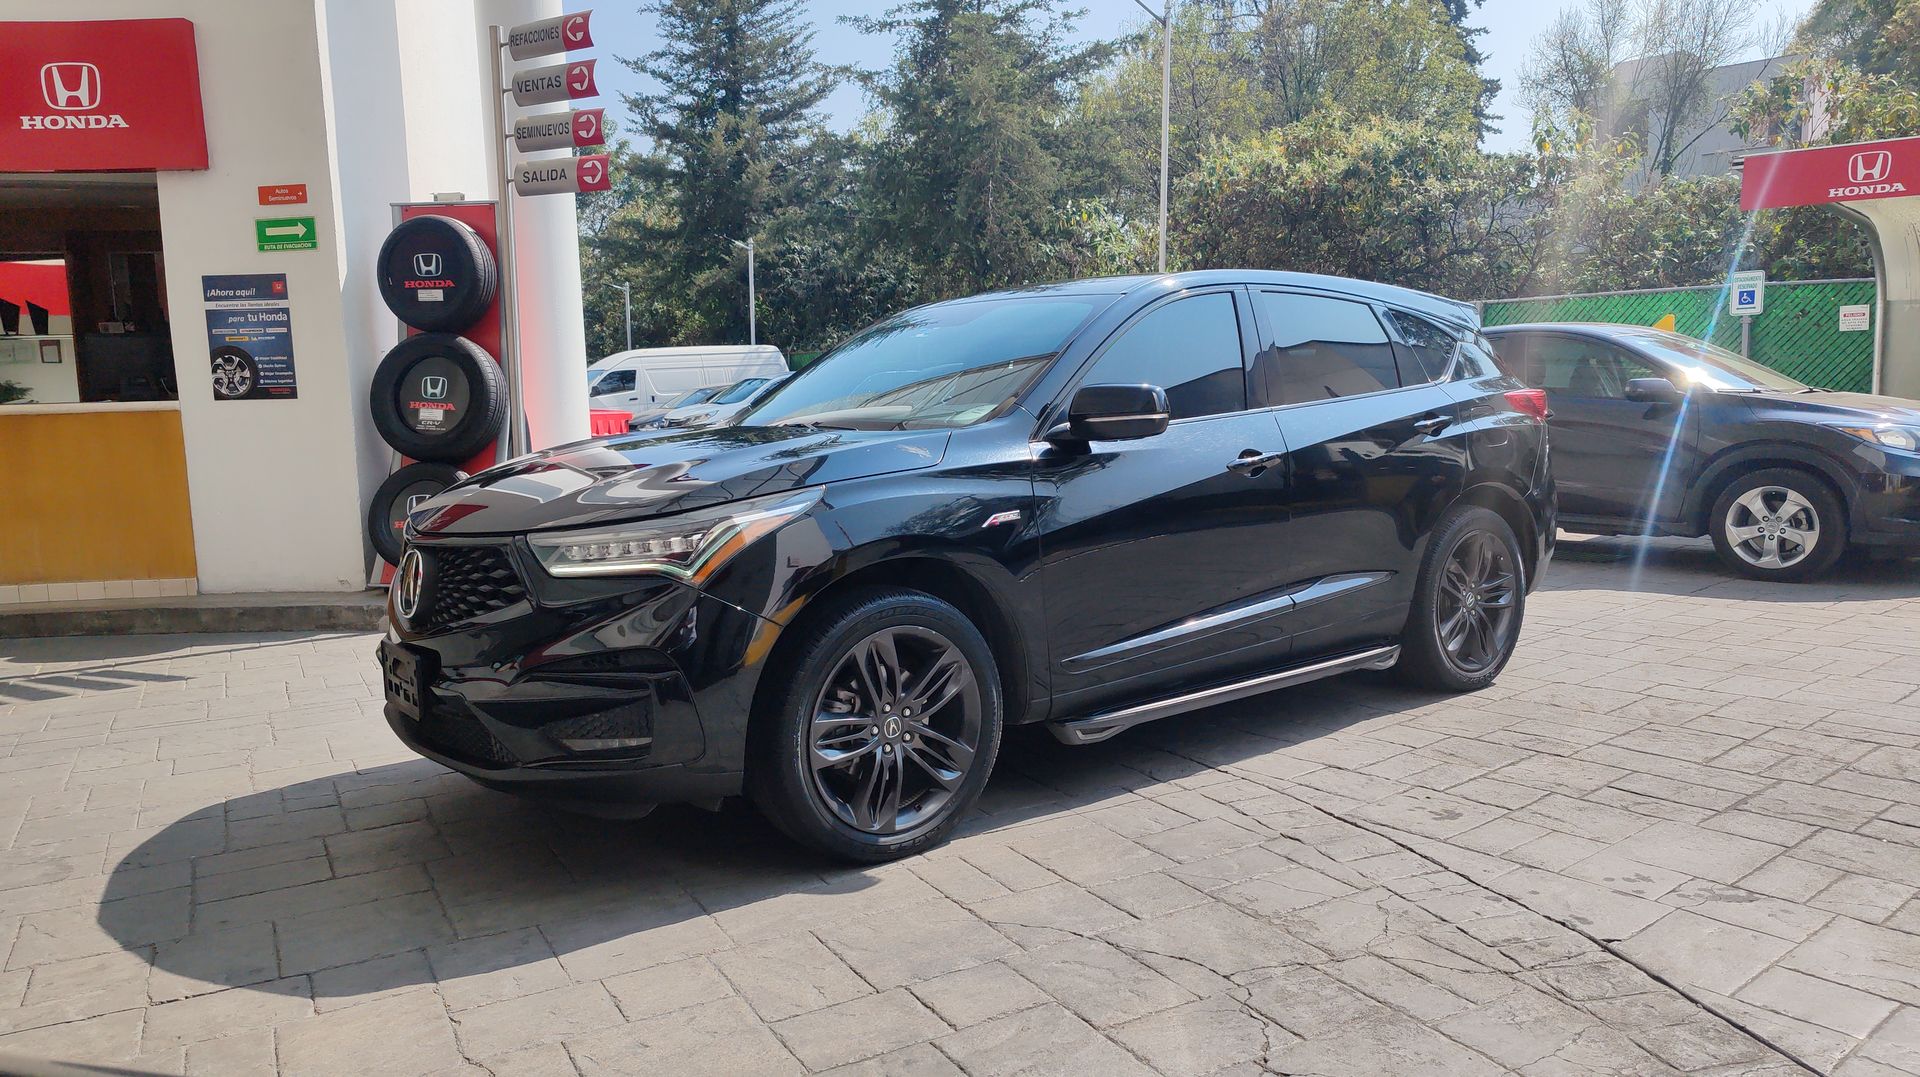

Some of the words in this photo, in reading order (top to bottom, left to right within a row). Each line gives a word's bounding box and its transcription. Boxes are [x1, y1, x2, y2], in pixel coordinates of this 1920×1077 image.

[510, 26, 560, 47] REFACCIONES
[517, 75, 562, 93] VENTAS
[20, 115, 129, 130] HONDA
[516, 121, 570, 140] SEMINUEVOS
[522, 168, 567, 184] SALIDA
[1828, 182, 1906, 198] HONDA
[404, 280, 456, 288] HONDA
[207, 288, 234, 298] ¡Ahora
[235, 287, 256, 297] aquí!
[228, 316, 245, 324] para
[247, 313, 258, 322] tu
[259, 311, 288, 322] Honda
[409, 401, 456, 411] HONDA
